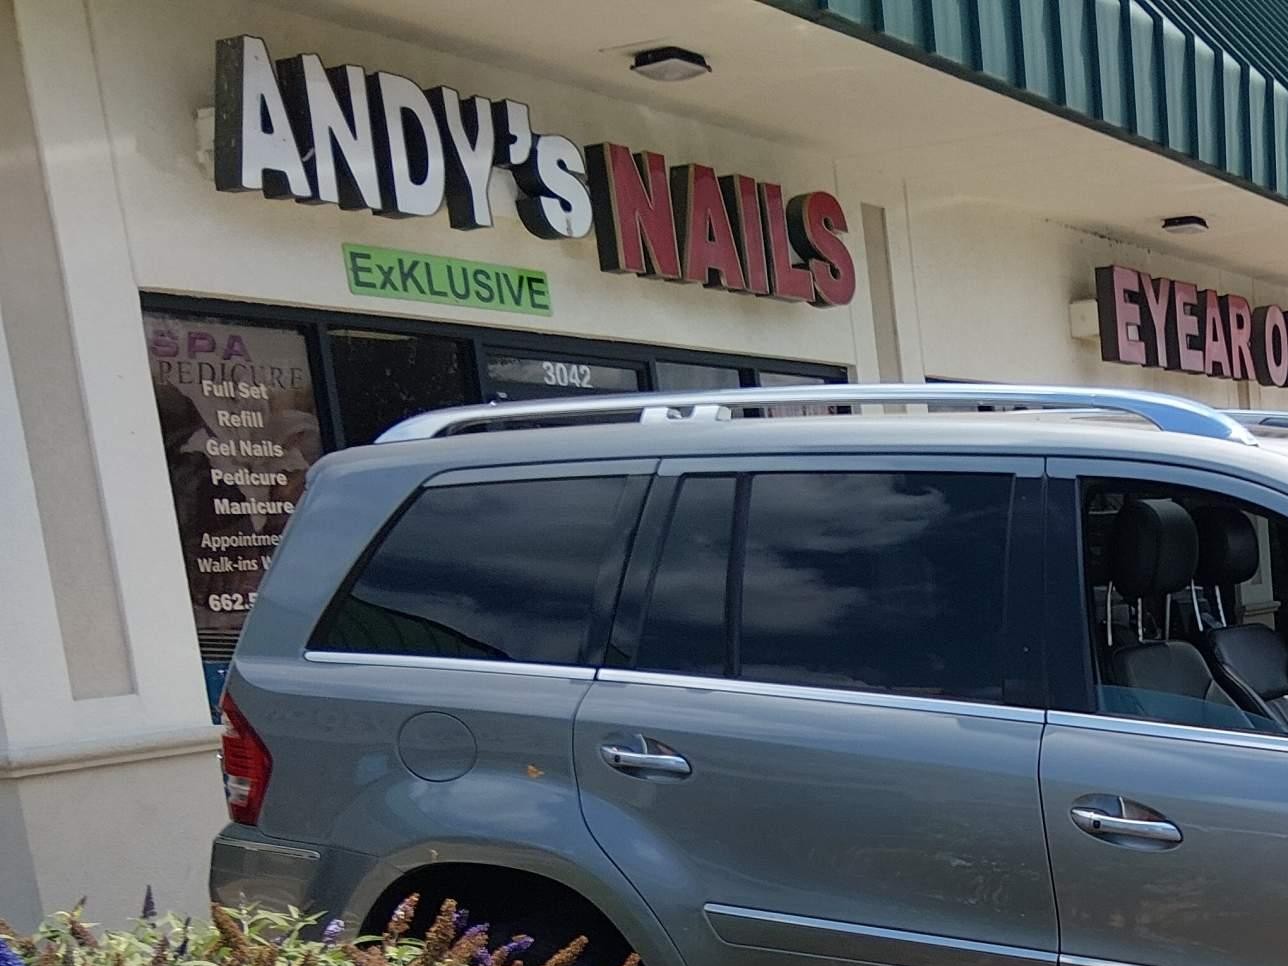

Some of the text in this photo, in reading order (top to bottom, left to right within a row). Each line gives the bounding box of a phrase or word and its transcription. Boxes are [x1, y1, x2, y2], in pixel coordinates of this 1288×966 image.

[588, 141, 857, 307] NAILS
[1096, 265, 1256, 381] EYEAR
[151, 329, 252, 361] SPA
[158, 360, 304, 390] PEDICURE
[542, 361, 593, 388] 3042
[202, 379, 269, 400] Full Set
[217, 410, 264, 428] Refill
[206, 438, 284, 458] Gel Nails
[211, 469, 288, 486] Pedicure
[214, 498, 296, 515] Manicure
[197, 556, 258, 573] Walk-ins
